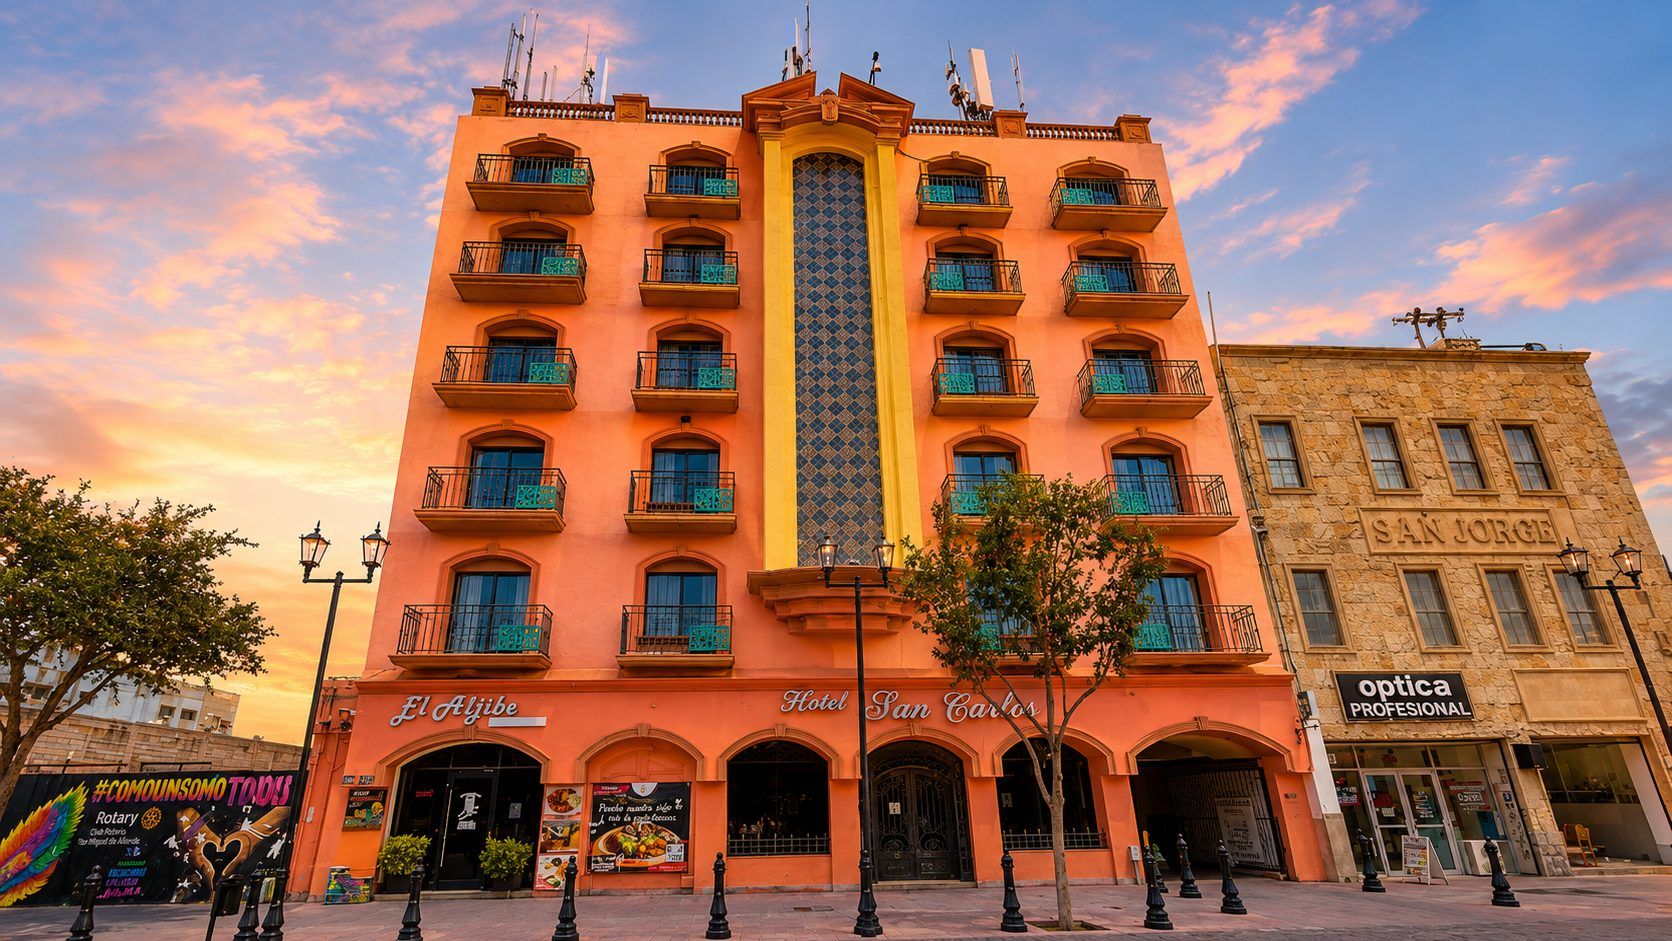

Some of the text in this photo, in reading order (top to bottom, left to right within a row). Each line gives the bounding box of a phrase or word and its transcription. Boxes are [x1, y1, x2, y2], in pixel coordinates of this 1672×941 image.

[1371, 518, 1556, 544] SAN JORGE
[1359, 674, 1452, 702] optica
[390, 695, 518, 727] El Aljibe
[780, 690, 1040, 723] Hotel San Carlos
[1350, 702, 1472, 717] PROFESIONAL
[95, 811, 139, 827] Rotary
